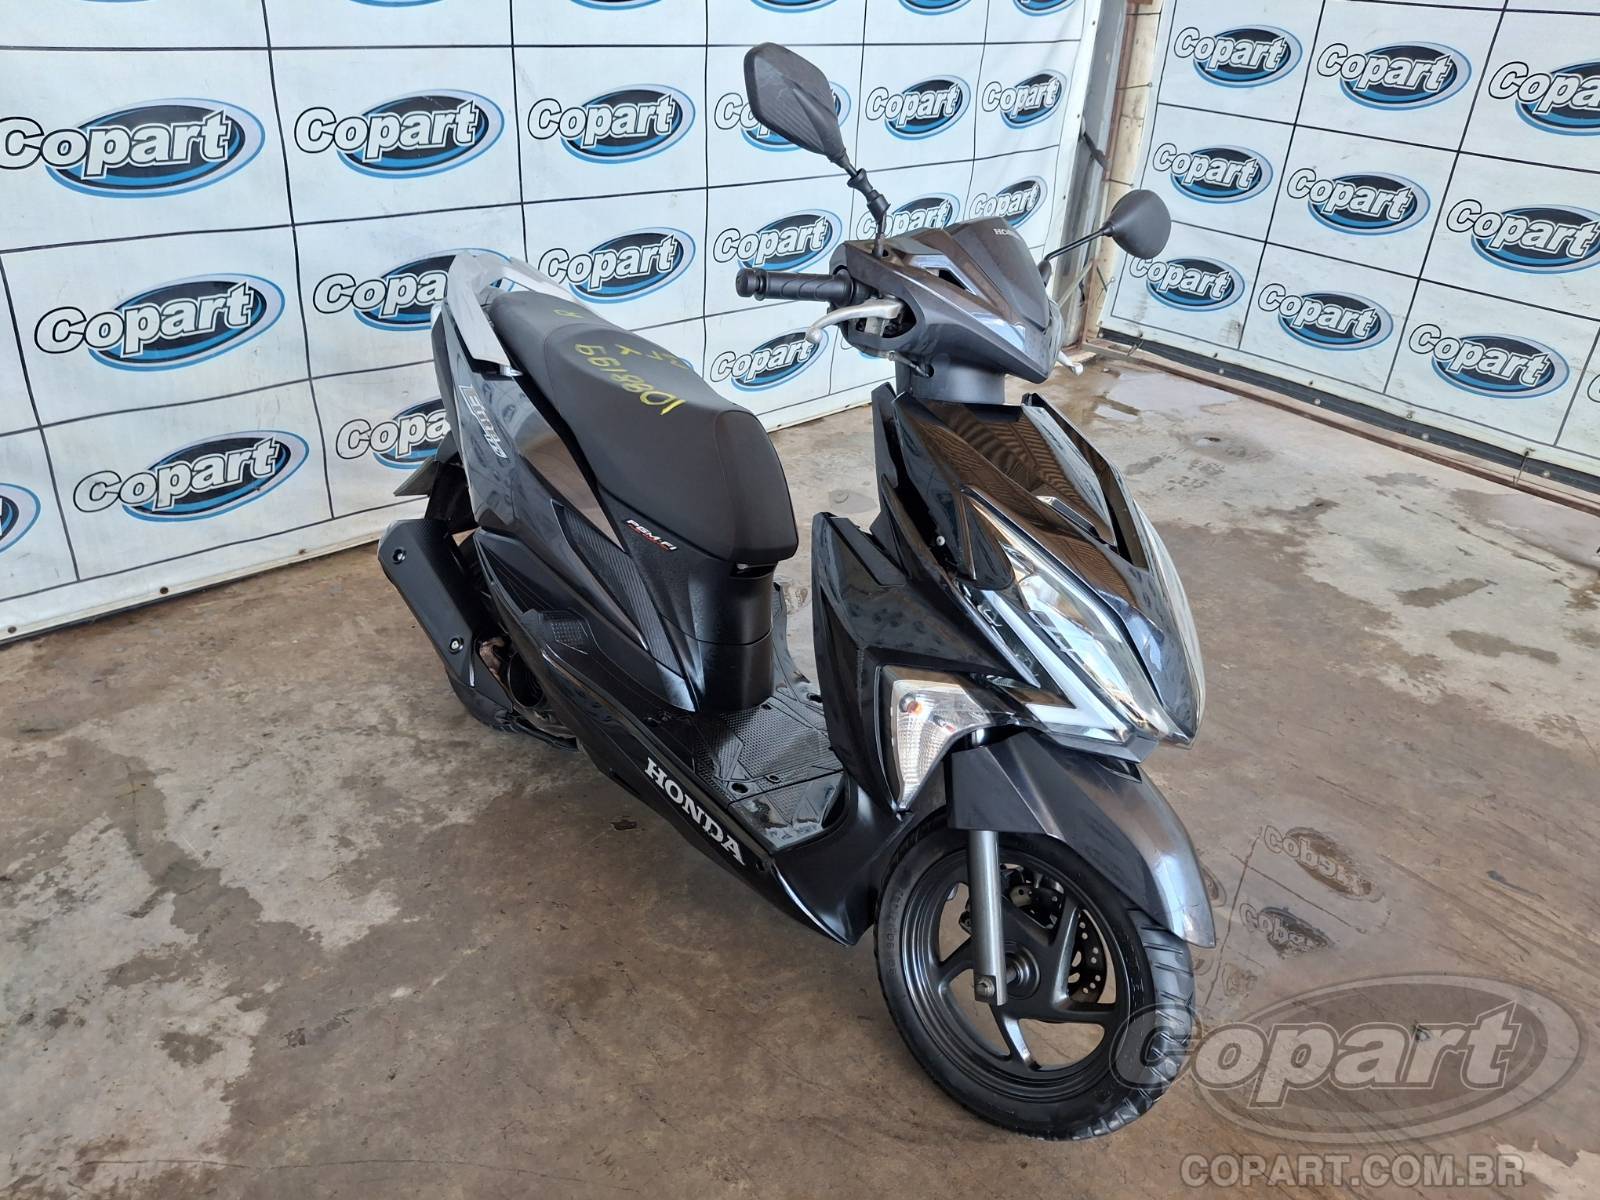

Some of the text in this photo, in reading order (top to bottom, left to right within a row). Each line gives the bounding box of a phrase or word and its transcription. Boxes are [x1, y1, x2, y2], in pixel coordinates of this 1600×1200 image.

[1174, 27, 1288, 71] Copart
[1317, 43, 1453, 91] Copart
[866, 80, 960, 128] Copart
[983, 75, 1057, 113] Copart
[1489, 62, 1600, 114] Copa
[0, 110, 232, 179] Copart
[294, 100, 480, 162] Copart
[528, 93, 677, 146] Copart
[1153, 143, 1262, 190] Copart
[970, 184, 1040, 217] Copart
[1287, 168, 1414, 220] Copart
[714, 217, 827, 265] Copart
[1447, 199, 1599, 258] Copart
[540, 235, 678, 285] Copart
[1129, 257, 1233, 301] Copart
[314, 272, 447, 317] Copa
[1258, 283, 1381, 338] Copart
[35, 283, 255, 357] Copart
[711, 338, 813, 383] Copart
[1408, 323, 1552, 387] Copart
[336, 409, 451, 459] Copa
[74, 437, 279, 512] Copart
[645, 757, 746, 865] HONDA
